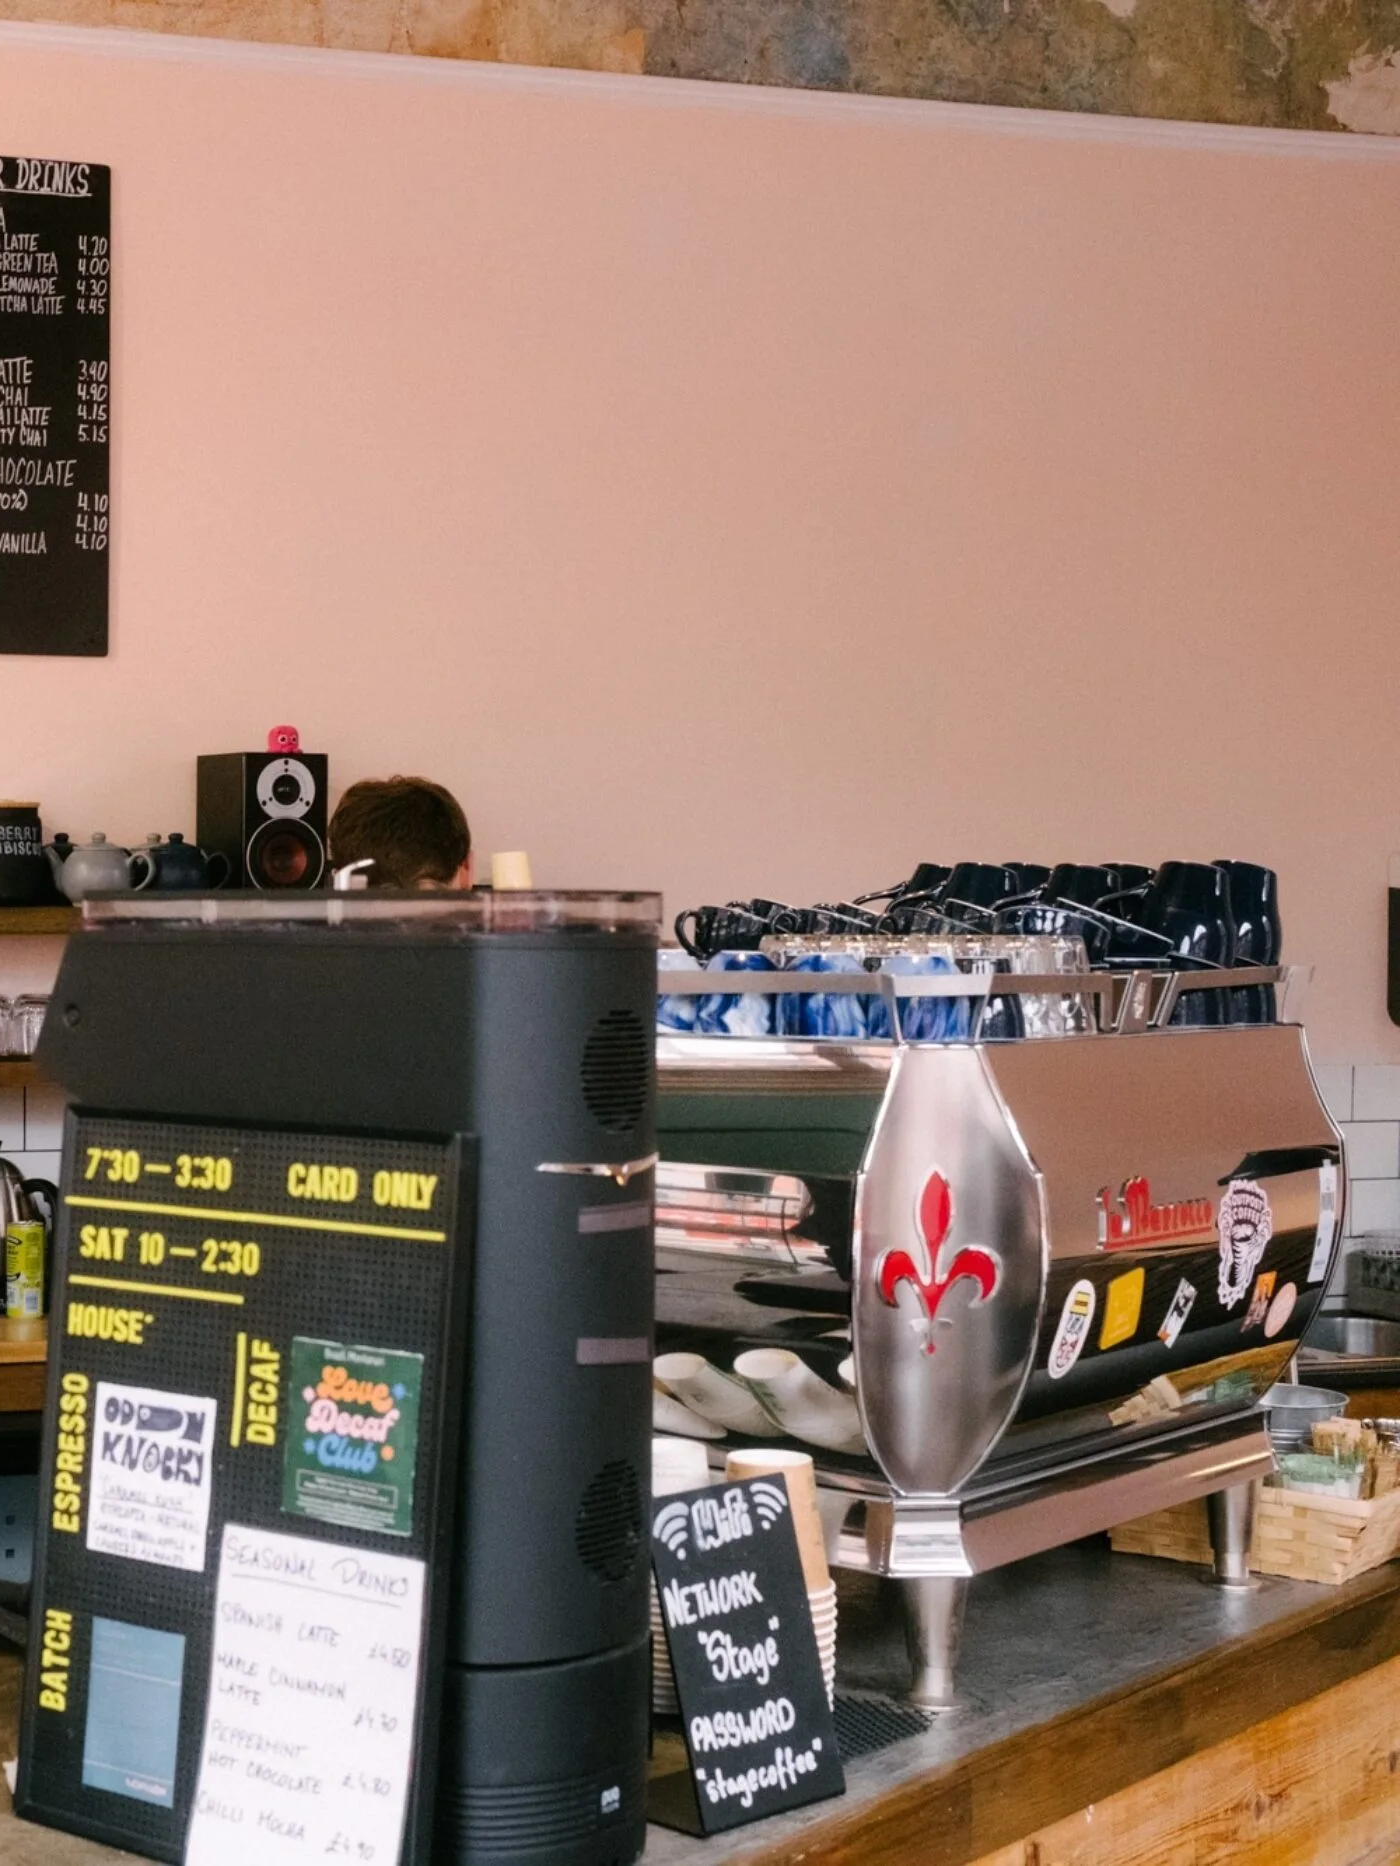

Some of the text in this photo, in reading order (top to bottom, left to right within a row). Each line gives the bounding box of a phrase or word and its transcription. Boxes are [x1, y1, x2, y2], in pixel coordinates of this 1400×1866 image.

[14, 157, 91, 196] DRINKS
[4, 233, 39, 251] LATTE
[35, 252, 59, 274] TEA
[77, 257, 110, 277] 4.00
[76, 278, 108, 297] 4.30
[31, 295, 66, 316] LATTE
[76, 298, 108, 316] 4.45
[13, 406, 52, 427] LATTE
[77, 403, 108, 422] 4.15
[19, 426, 48, 447] CHAI
[77, 424, 108, 443] 5.15
[77, 492, 108, 513] 4.10
[75, 514, 108, 533] 4.10
[74, 533, 108, 551] 4.10
[287, 1163, 439, 1211] CARD ONLY
[79, 1224, 130, 1262] SAT
[245, 1338, 281, 1446] DECAF
[305, 1398, 401, 1443] Decaf
[52, 1372, 90, 1534] ESPRESSO
[317, 1432, 378, 1474] Club
[225, 1535, 316, 1582] SEASONAL
[331, 1556, 409, 1596] DRINKS
[662, 1570, 765, 1630] NETWORK
[297, 1624, 343, 1647] LATTE
[39, 1608, 74, 1712] BATCH
[690, 1697, 797, 1753] PASSWORD
[207, 1751, 239, 1769] HOT
